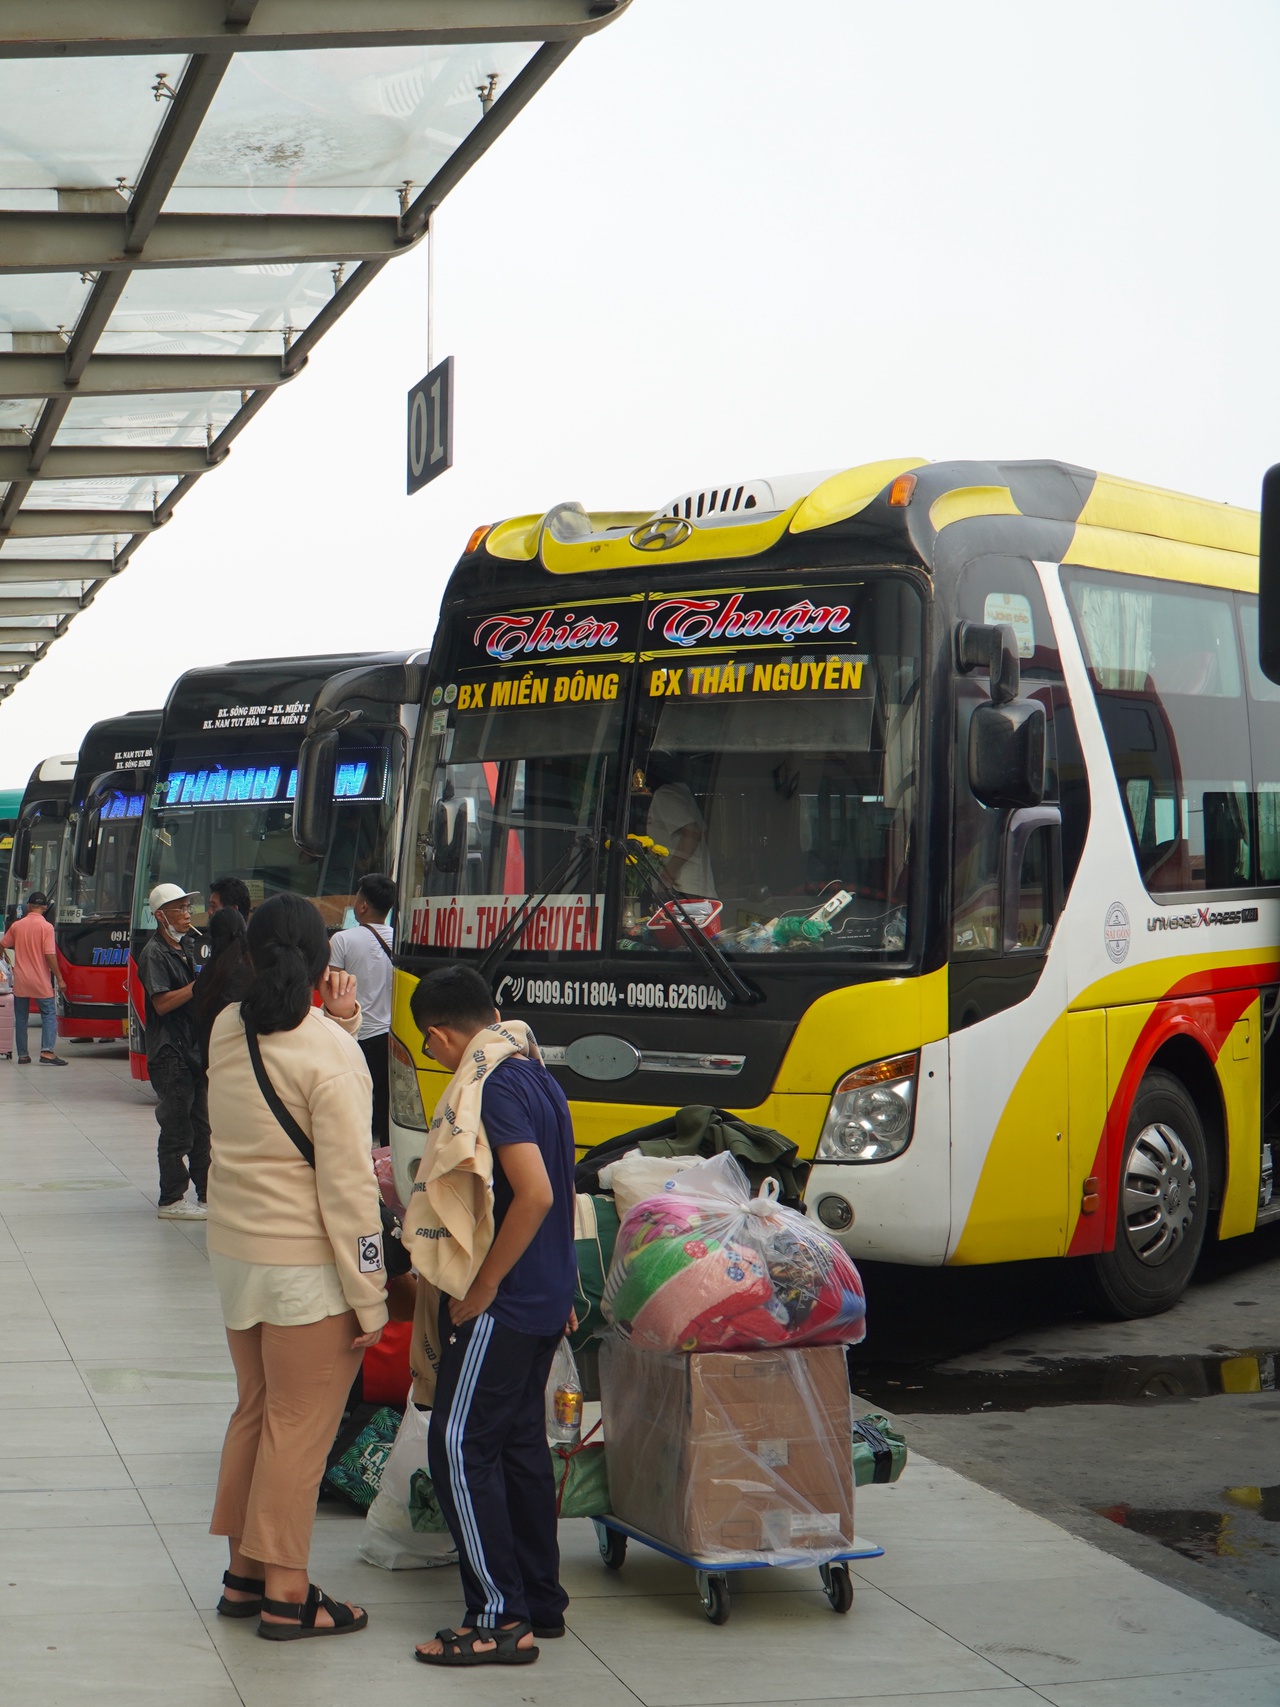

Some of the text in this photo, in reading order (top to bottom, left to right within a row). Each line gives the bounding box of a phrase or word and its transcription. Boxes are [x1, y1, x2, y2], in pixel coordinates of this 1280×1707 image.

[410, 376, 444, 477] 01
[474, 594, 851, 661] Thiên Thuận
[457, 670, 619, 710] BX MIỀN ĐÔNG
[649, 656, 864, 697] BX THÁI NGUYÊN
[203, 720, 214, 730] BX.
[214, 719, 230, 729] NAM
[230, 717, 245, 728] TUY
[268, 716, 280, 725] BX.
[217, 708, 230, 718] BX.
[230, 704, 248, 716] SÔNG
[249, 705, 267, 715] HINH
[273, 704, 284, 714] BX.
[166, 764, 280, 803] THÀNH
[410, 899, 430, 945] HÀ
[520, 896, 599, 950] NGUYÊN
[527, 979, 617, 1006] 0909.611804
[360, 1456, 378, 1473] ULTRA
